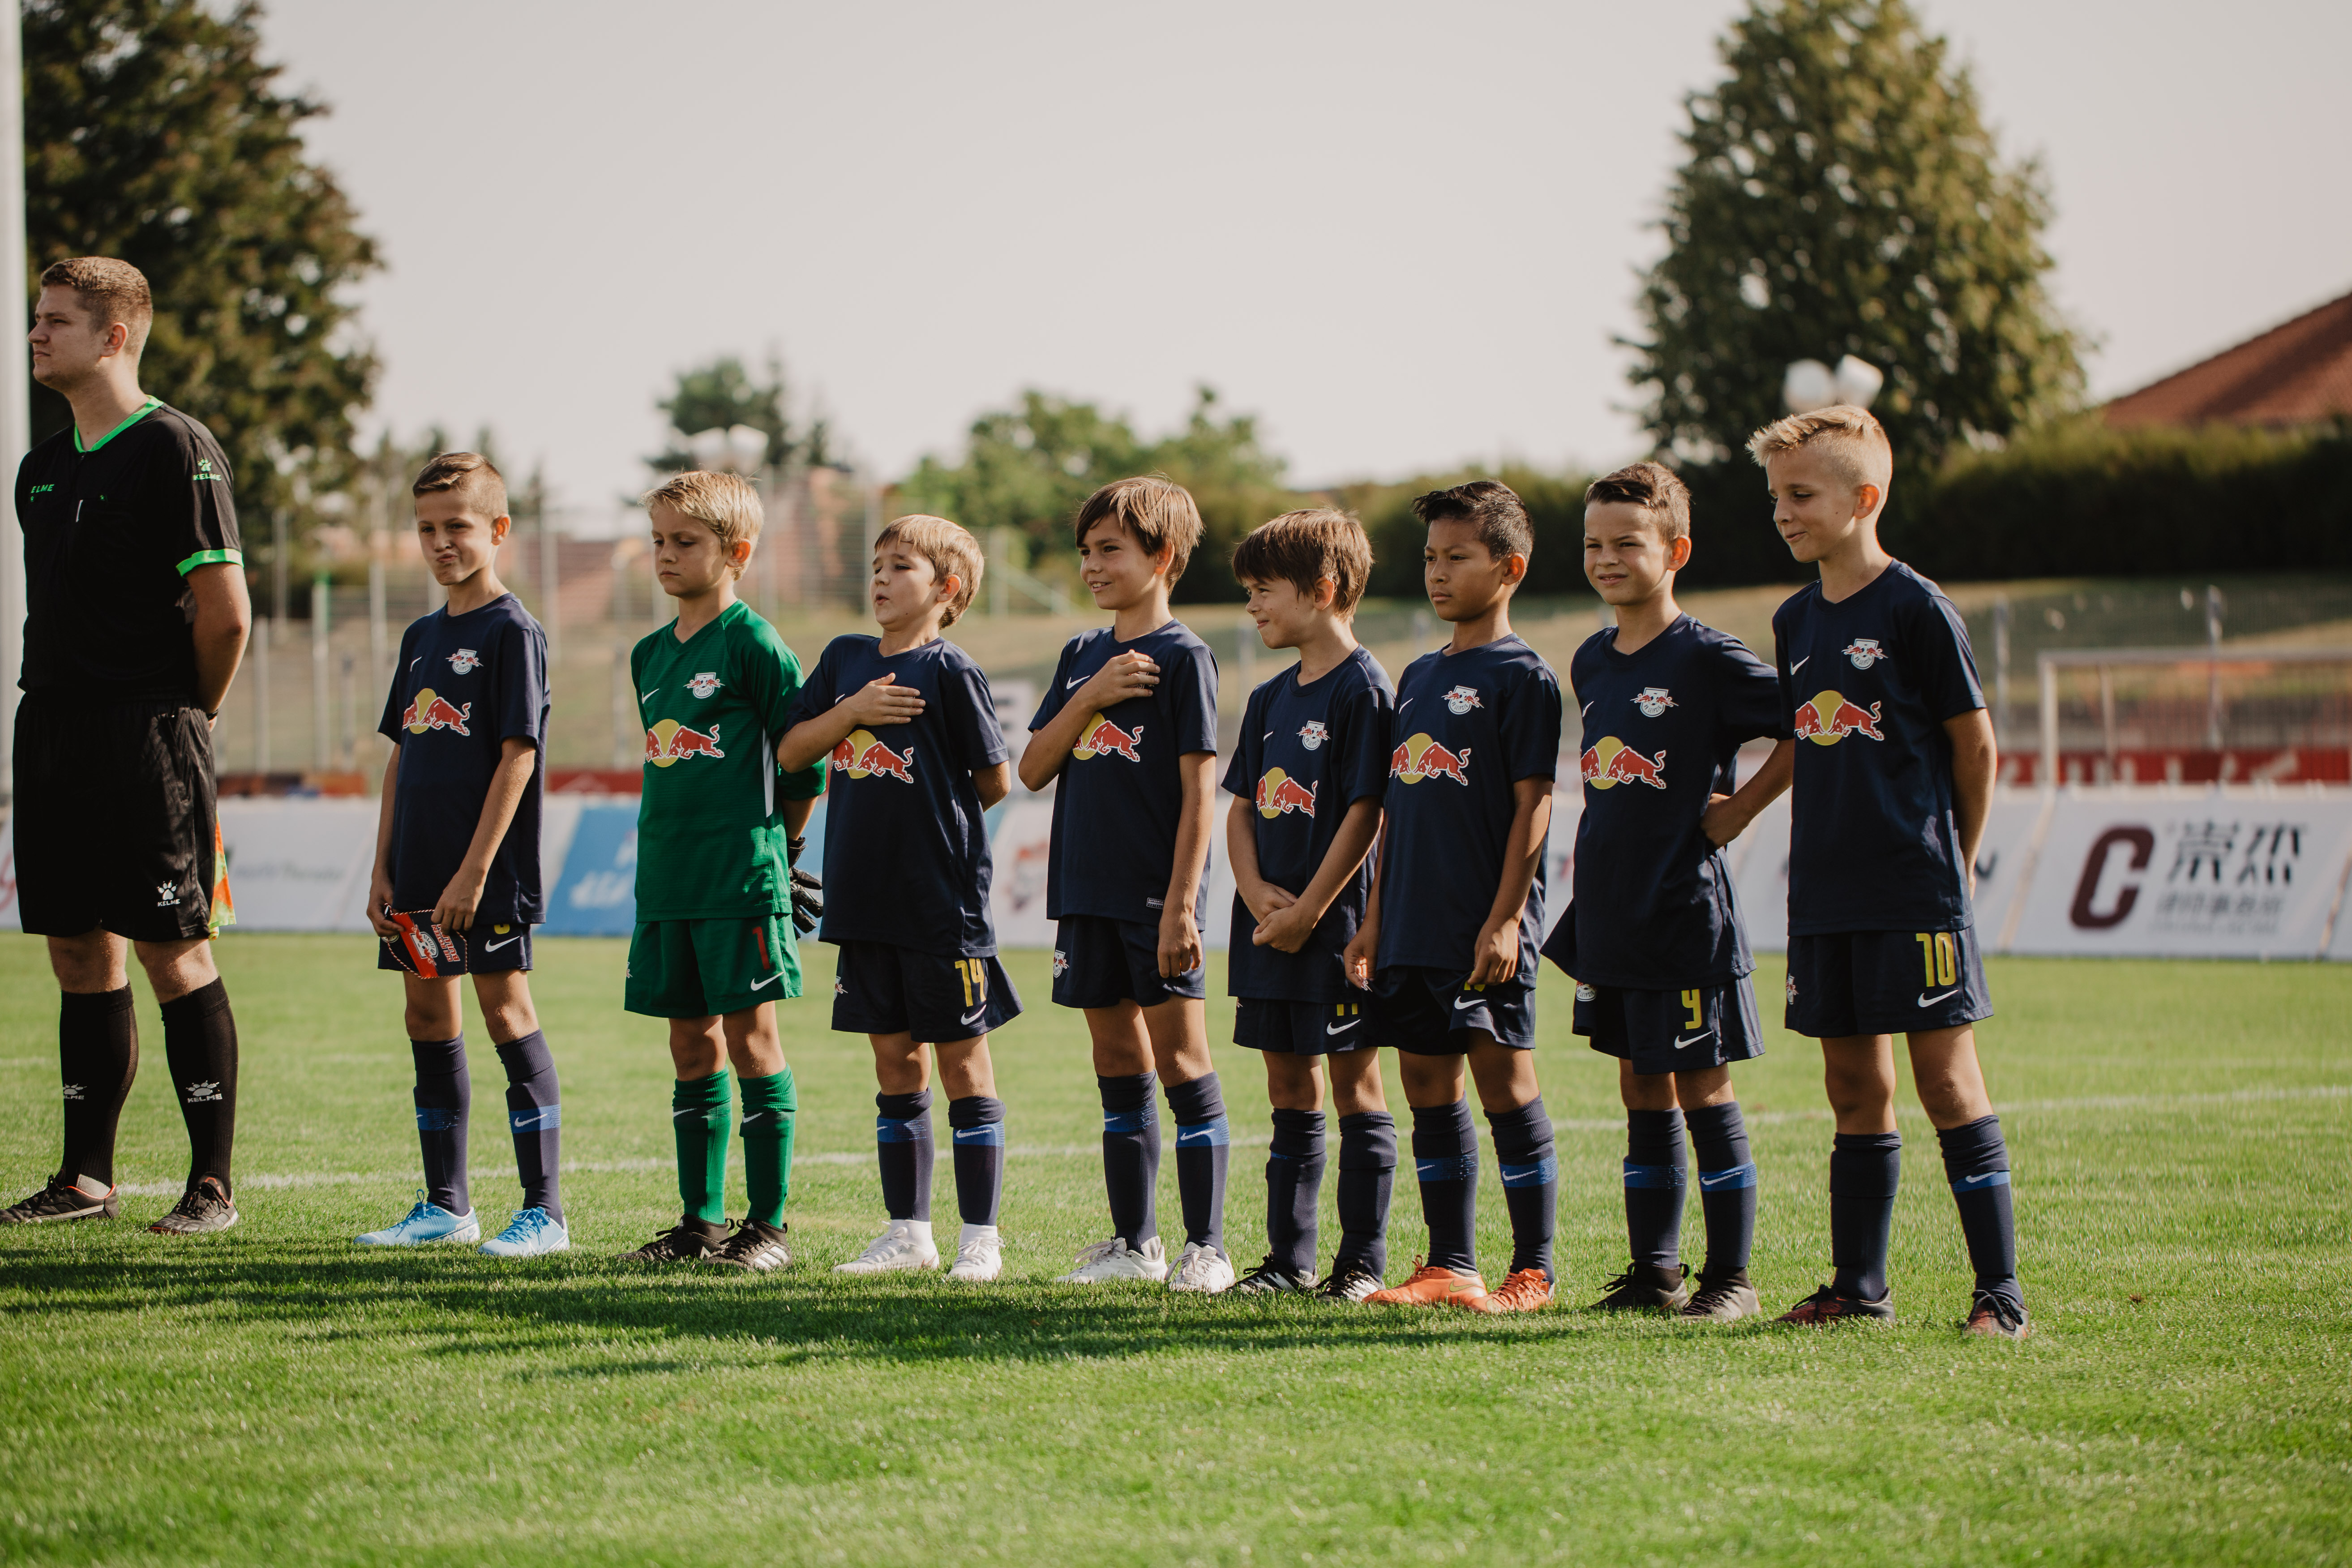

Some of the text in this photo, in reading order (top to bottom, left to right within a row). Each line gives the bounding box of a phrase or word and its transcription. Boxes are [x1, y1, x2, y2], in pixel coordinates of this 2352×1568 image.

[30, 484, 55, 493] ELME
[2071, 825, 2155, 929] C
[431, 924, 453, 962] DIE ROTEN
[437, 924, 461, 962] BULL
[752, 926, 770, 970] 1
[1916, 932, 1956, 987] 10
[955, 958, 986, 1007] 14
[1681, 989, 1702, 1030] 9
[188, 1093, 223, 1103] KELME
